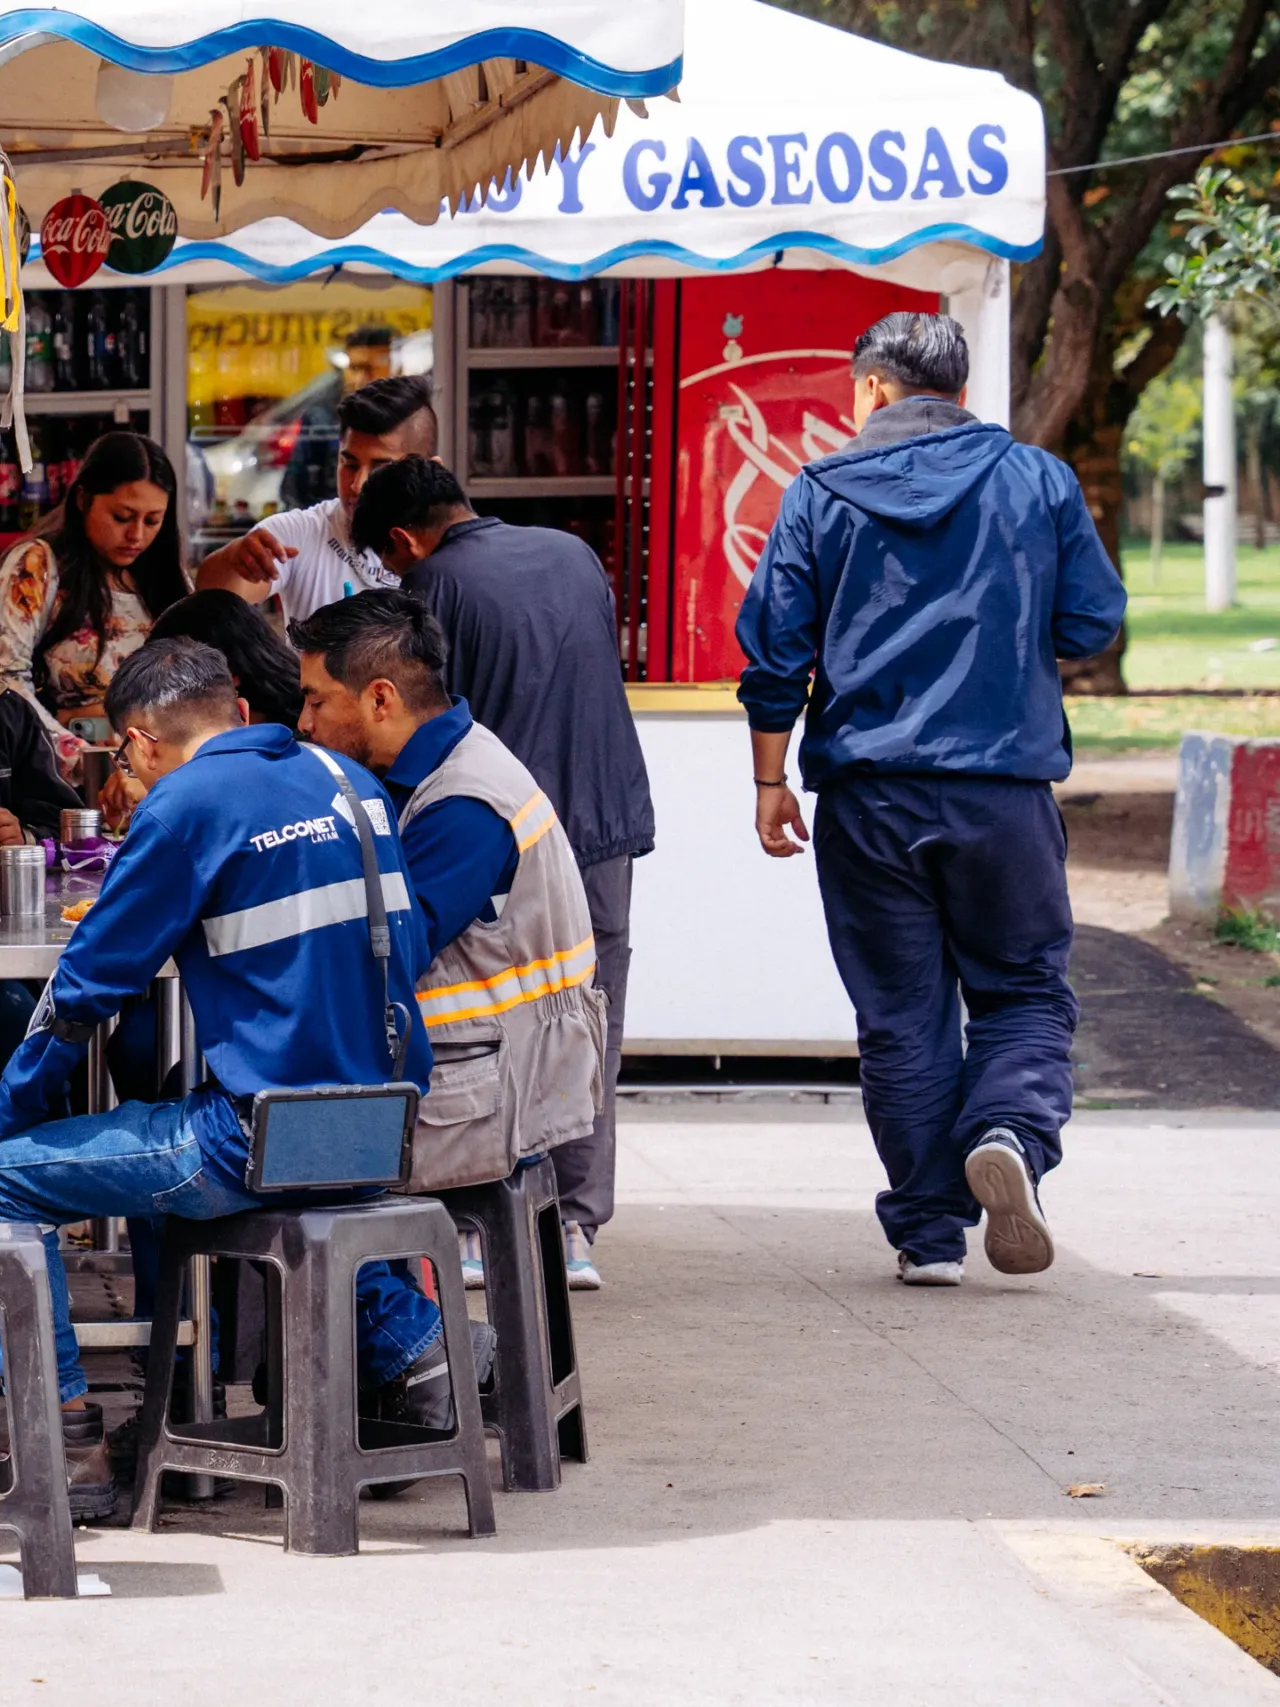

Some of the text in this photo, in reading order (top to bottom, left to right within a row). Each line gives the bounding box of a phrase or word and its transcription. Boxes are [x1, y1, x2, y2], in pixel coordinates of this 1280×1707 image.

[553, 138, 596, 214] Y
[622, 123, 1009, 212] GASEOSAS
[249, 815, 335, 852] TELCONET
[310, 831, 339, 844] LATAM
